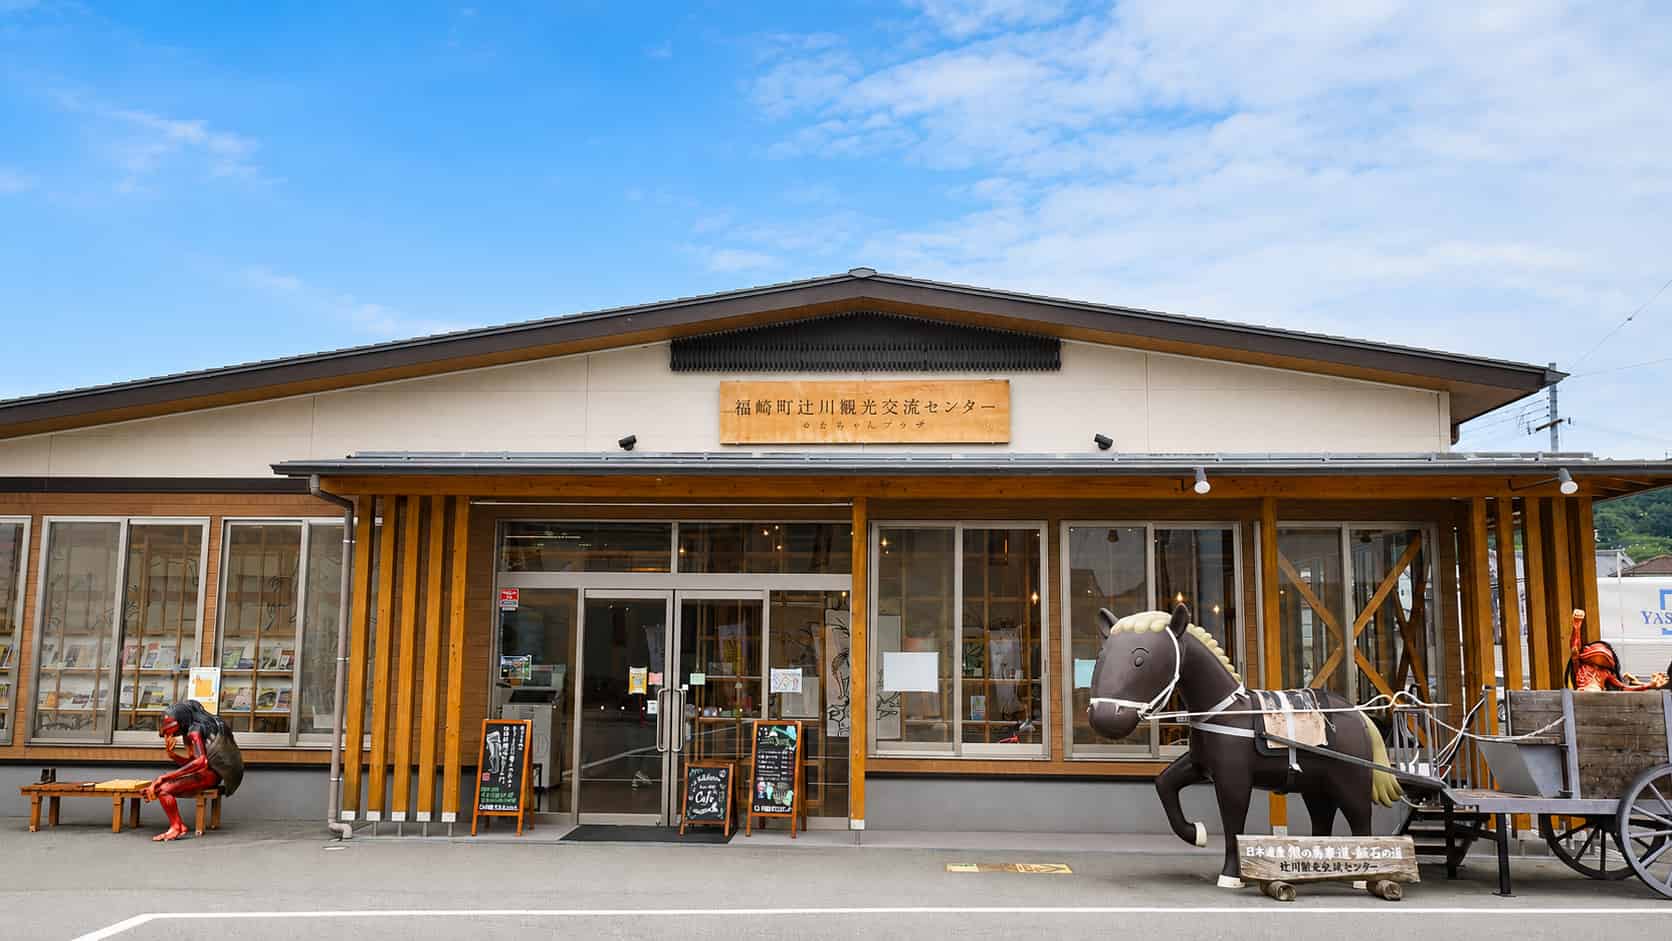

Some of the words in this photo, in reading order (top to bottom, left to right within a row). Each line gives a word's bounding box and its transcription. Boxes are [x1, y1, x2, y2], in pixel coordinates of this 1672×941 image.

[735, 399, 996, 416] 福崎町辻川観光交流センター
